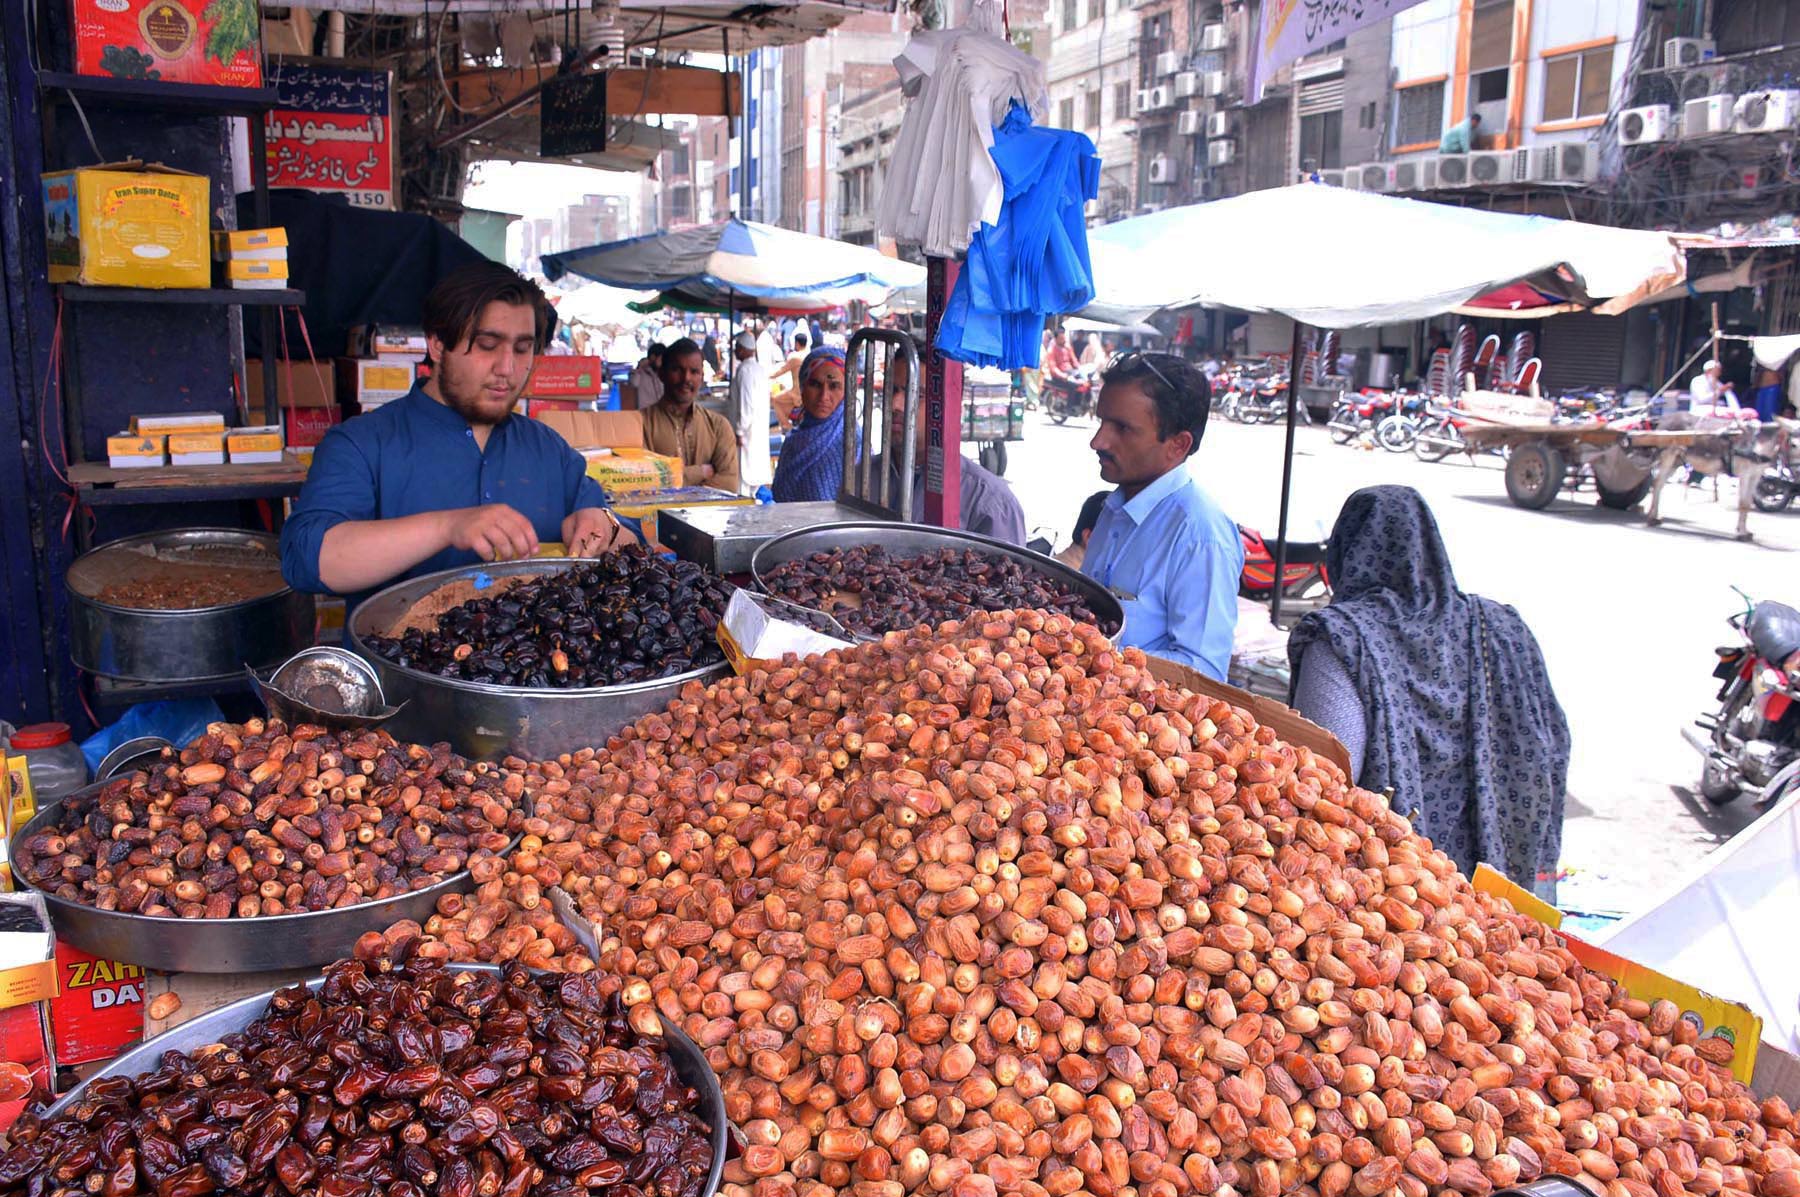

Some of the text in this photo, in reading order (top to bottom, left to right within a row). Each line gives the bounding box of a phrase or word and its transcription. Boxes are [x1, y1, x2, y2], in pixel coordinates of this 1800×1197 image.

[220, 73, 246, 82] IRAN
[343, 147, 379, 186] طبی
[67, 960, 145, 988] ZAH
[92, 982, 144, 1009] DA
